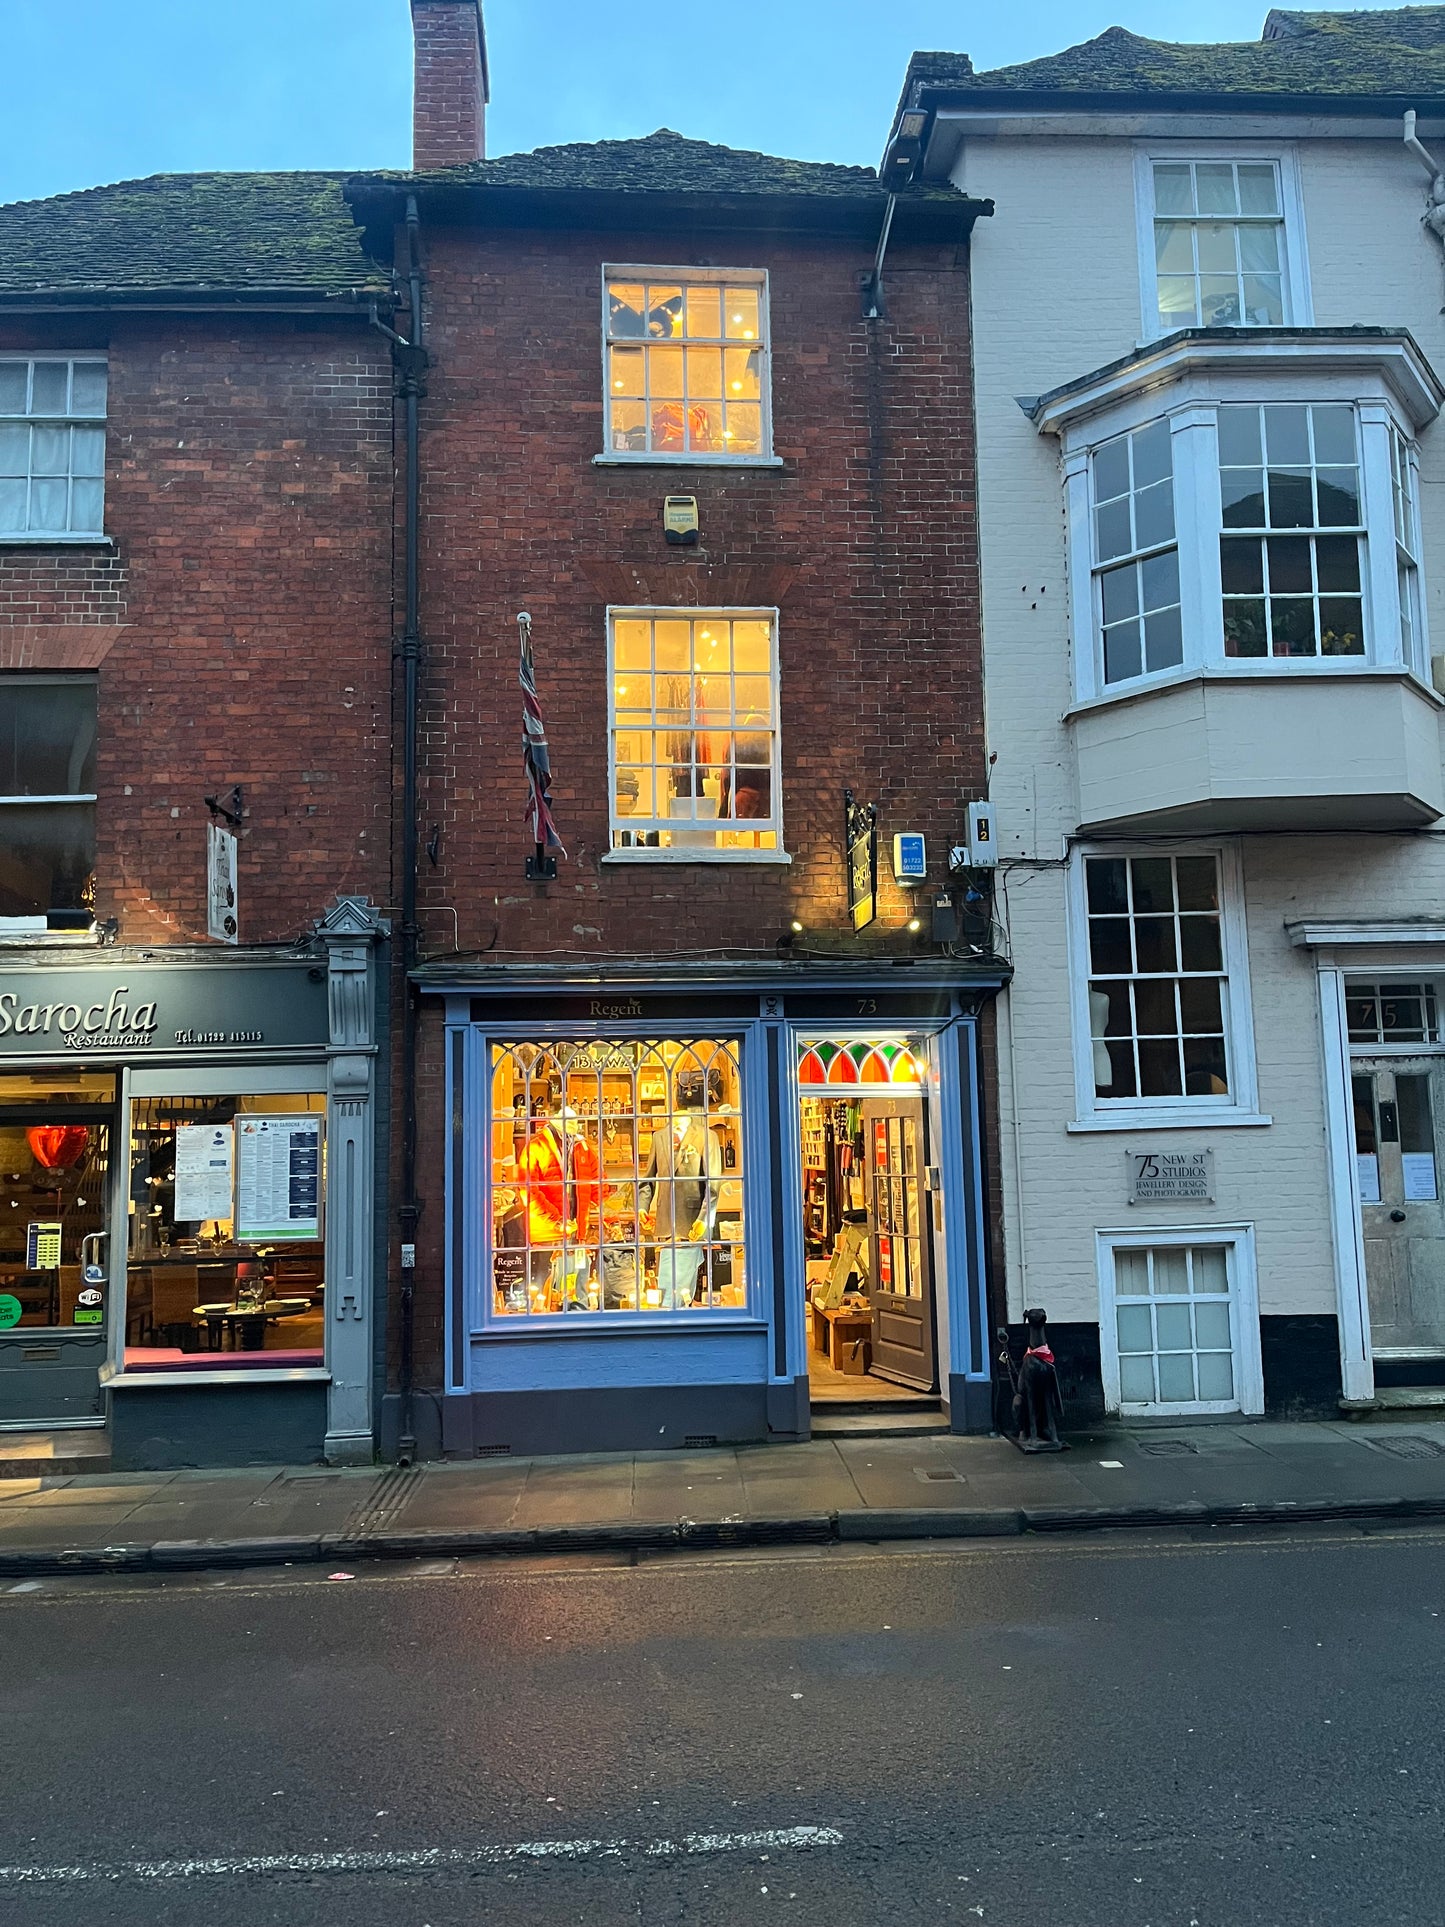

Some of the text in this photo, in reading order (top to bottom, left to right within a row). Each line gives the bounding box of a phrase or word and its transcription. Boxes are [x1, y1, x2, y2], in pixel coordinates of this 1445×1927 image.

[0, 987, 156, 1034] Sarocha
[590, 999, 643, 1020] Regent
[857, 999, 877, 1014] 73
[1361, 1003, 1398, 1027] 75
[63, 1031, 152, 1049] Restaurant
[887, 1100, 897, 1115] 73
[1135, 1154, 1206, 1178] 75 NEW ST
[1162, 1166, 1207, 1177] STUDIOS
[1136, 1180, 1208, 1189] JEWELLERY DESIGN
[1136, 1189, 1207, 1198] AND PHOTOGRAPHY
[497, 1257, 523, 1268] Regent
